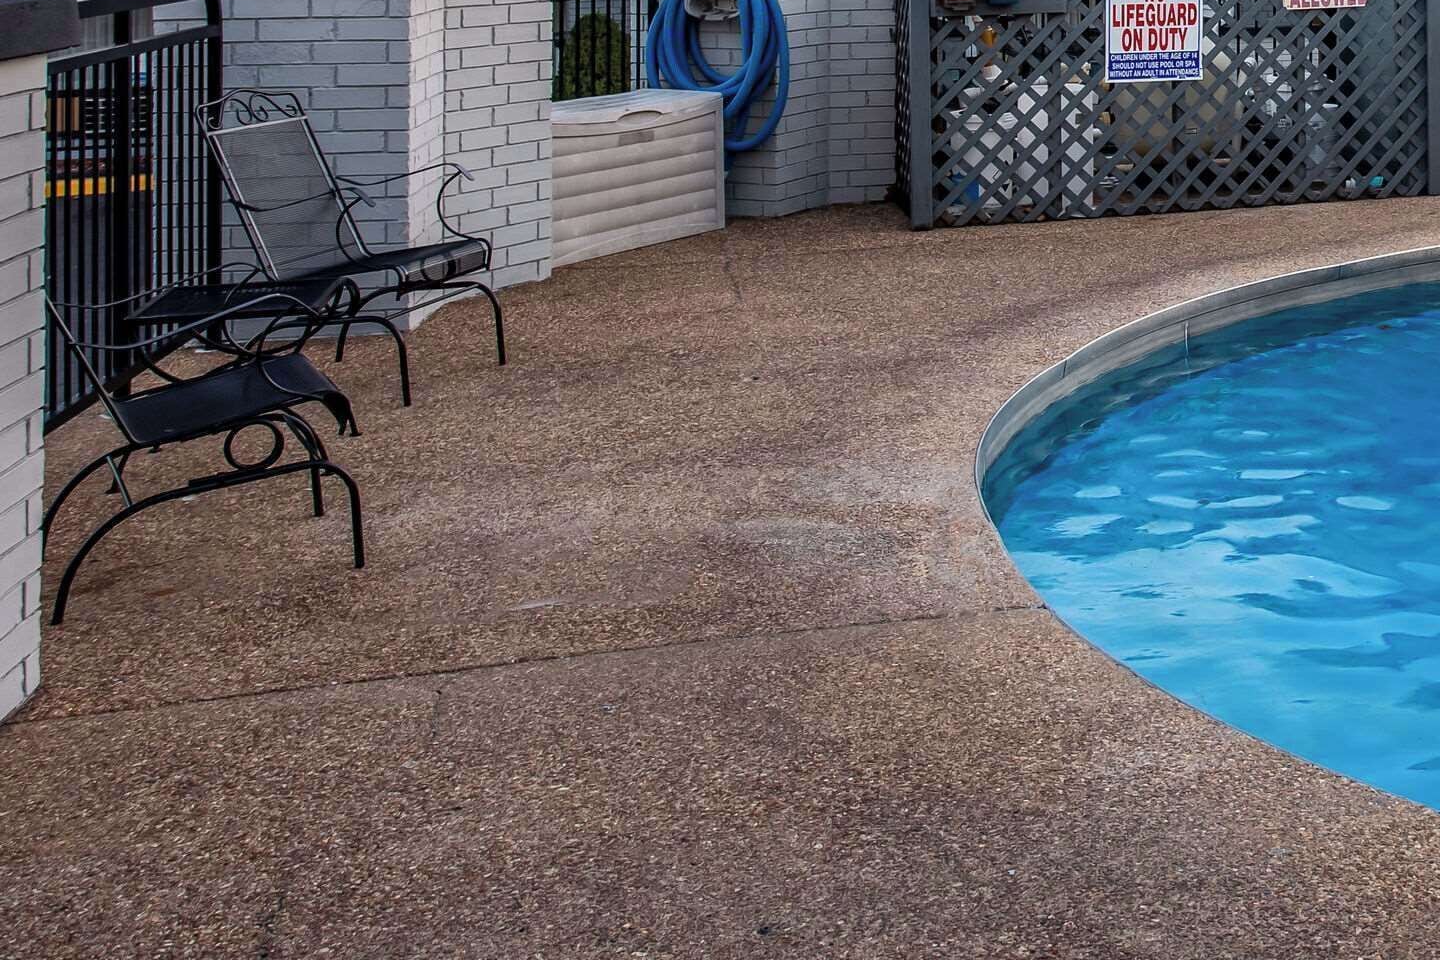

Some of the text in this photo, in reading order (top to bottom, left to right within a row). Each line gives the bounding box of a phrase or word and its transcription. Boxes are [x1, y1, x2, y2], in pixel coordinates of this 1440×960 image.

[1112, 3, 1198, 27] LIFEGUARD
[1121, 27, 1188, 52] ON DUTY
[1170, 52, 1182, 60] AGE
[1112, 62, 1135, 70] SHOULD
[1109, 70, 1133, 78] WITHOUT
[1141, 69, 1159, 77] ADULT
[1165, 68, 1199, 76] ATTENDANCE
